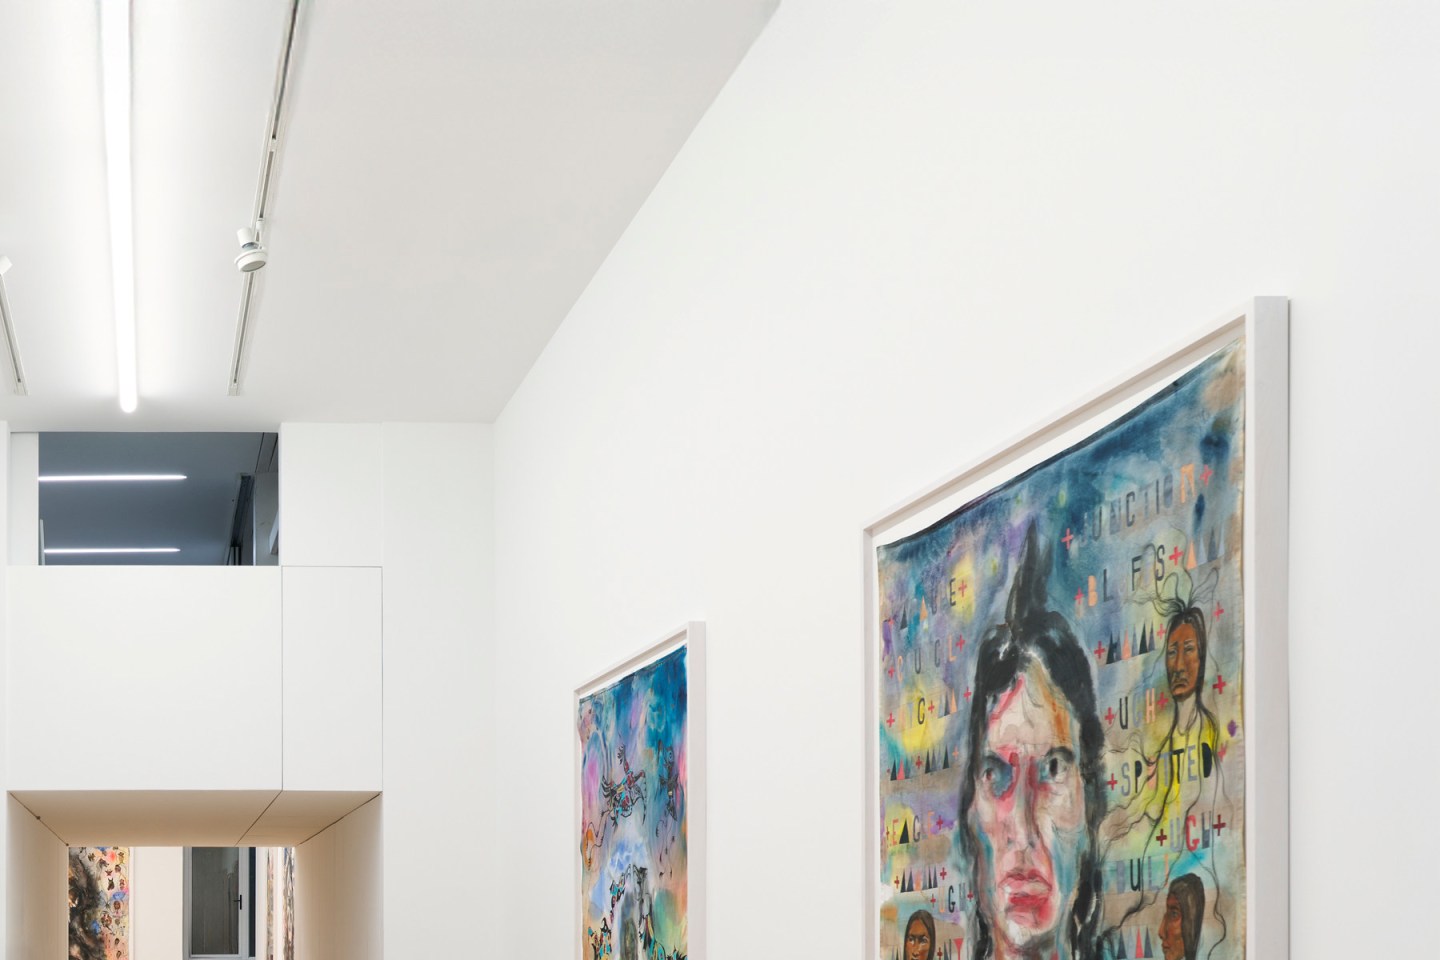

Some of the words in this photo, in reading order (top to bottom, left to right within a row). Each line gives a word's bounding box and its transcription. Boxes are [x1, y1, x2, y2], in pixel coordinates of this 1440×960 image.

[1081, 463, 1196, 545] JUNCTION
[1088, 545, 1165, 607] BLFS
[1119, 688, 1156, 730] UGH
[1121, 742, 1213, 797] SPOTTED
[1170, 811, 1212, 853] UGH
[938, 884, 966, 913] UGH
